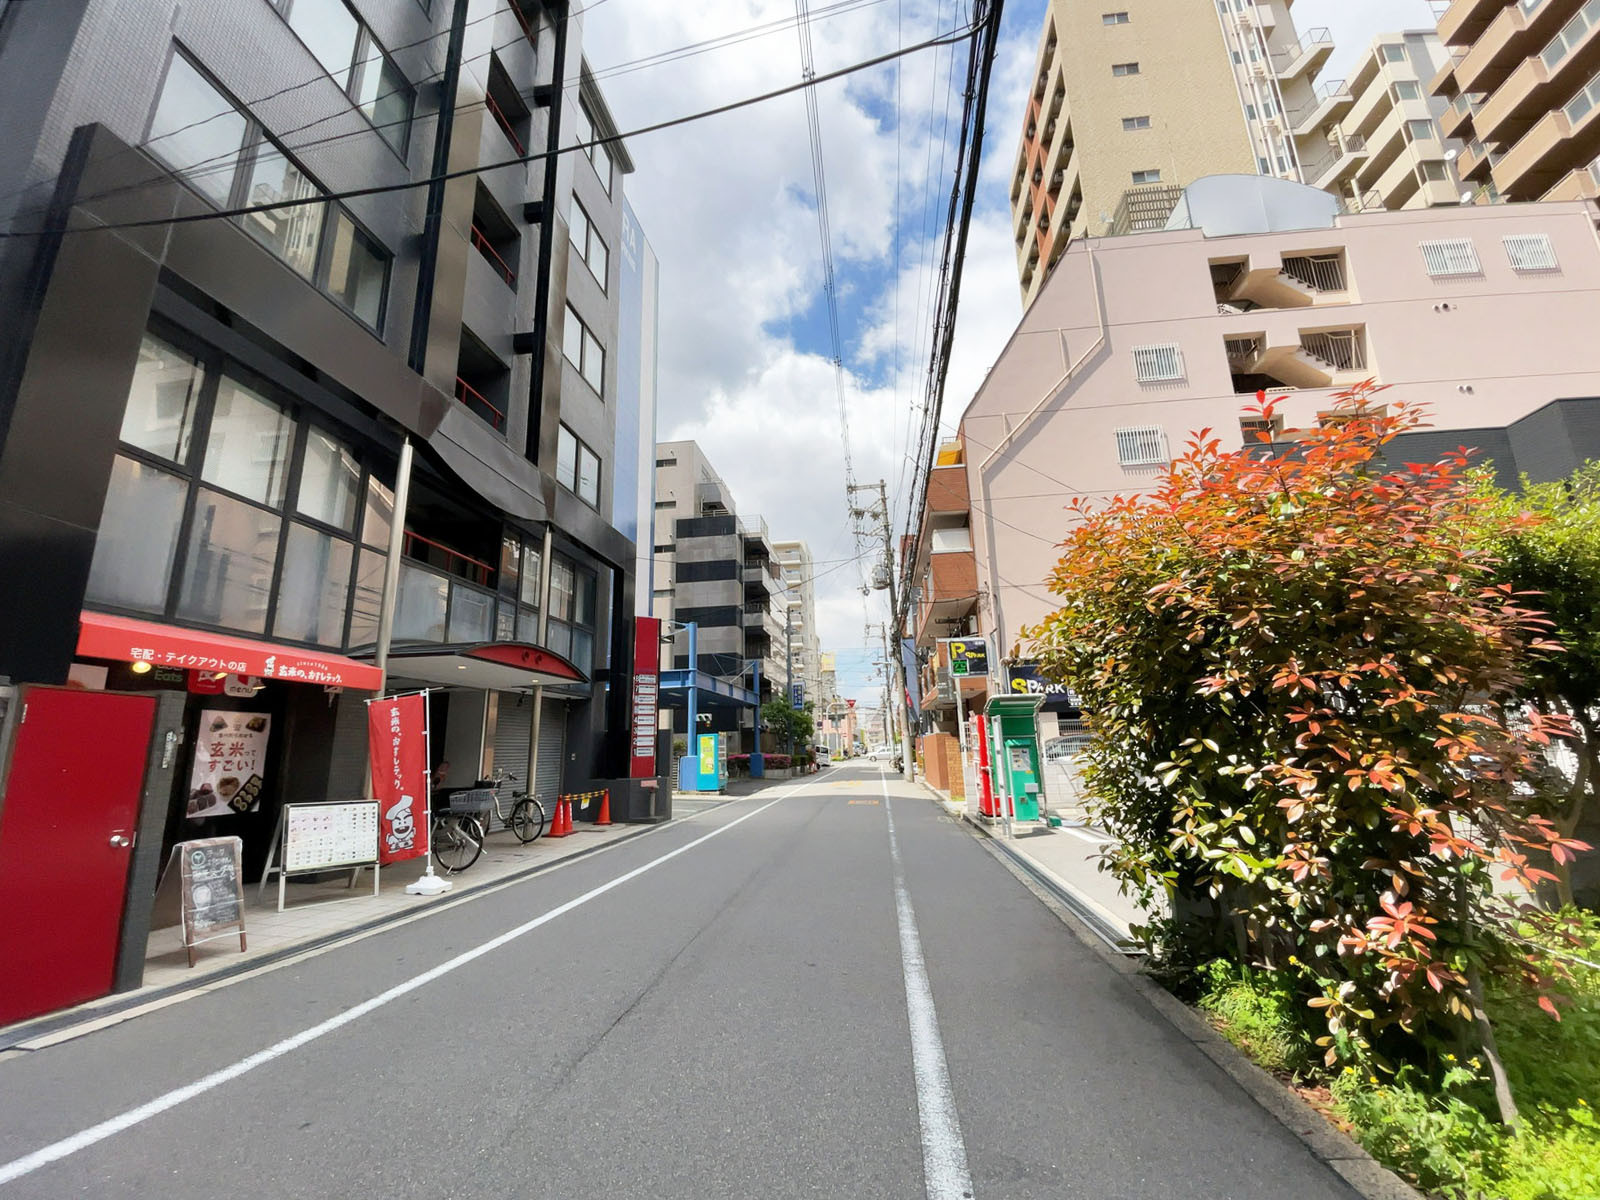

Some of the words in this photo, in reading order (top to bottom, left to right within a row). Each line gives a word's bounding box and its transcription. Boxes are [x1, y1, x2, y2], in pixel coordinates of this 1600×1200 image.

[130, 647, 247, 672] 宅配・テイクアウトの店
[951, 642, 966, 660] P
[210, 741, 257, 757] 玄米って
[208, 759, 256, 773] すごい!
